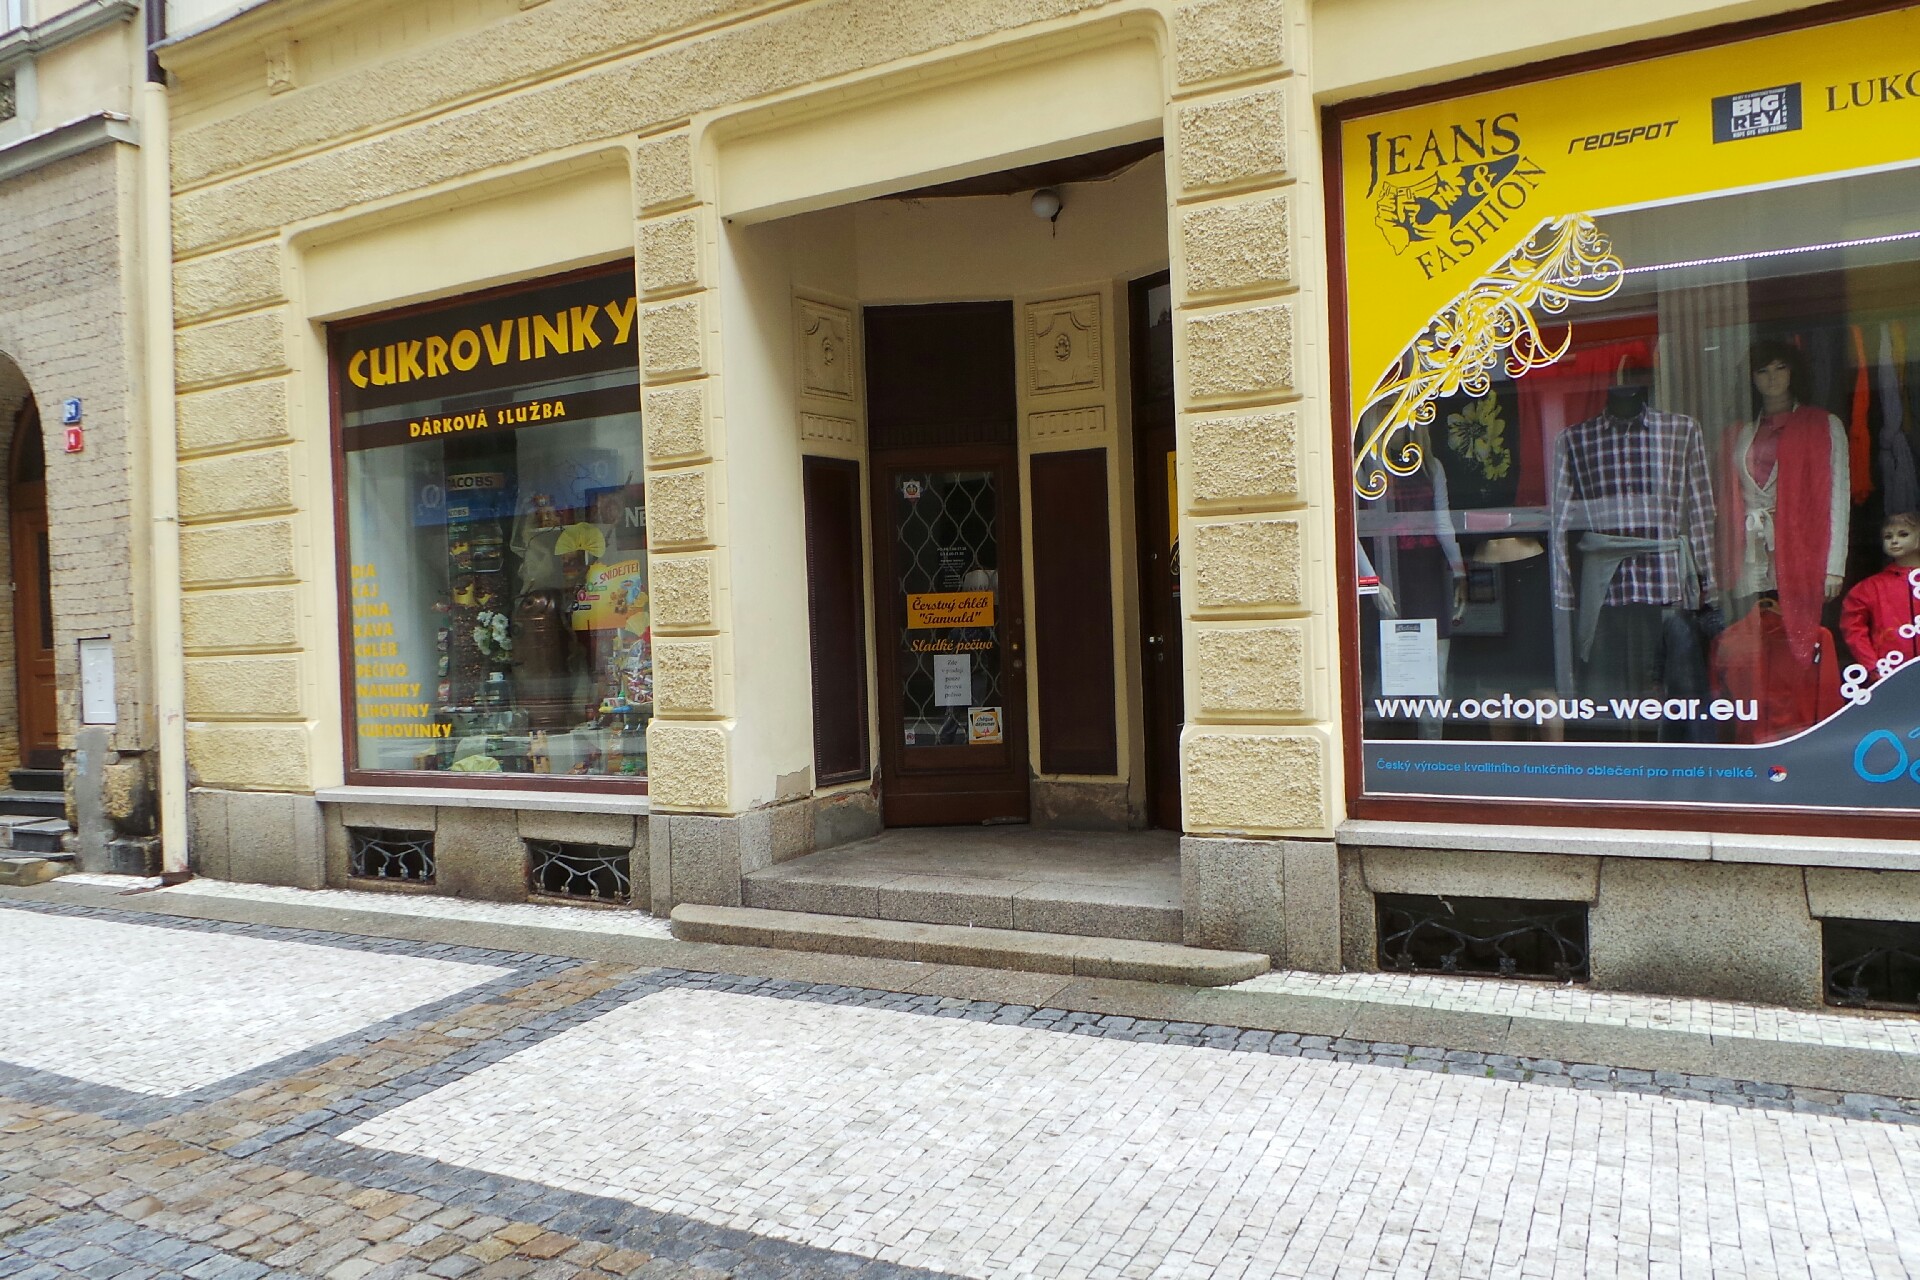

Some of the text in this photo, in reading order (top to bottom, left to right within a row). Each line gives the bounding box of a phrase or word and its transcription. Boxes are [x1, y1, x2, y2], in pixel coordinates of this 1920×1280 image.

[1732, 94, 1779, 117] BIG
[1731, 109, 1781, 133] REY
[1366, 113, 1521, 199] JEANS
[1467, 164, 1498, 197] &
[1414, 156, 1547, 281] FASHION
[349, 297, 637, 388] CUKROVINKY
[409, 401, 566, 438] DÁRKOVÁ SLUŽBA
[912, 596, 988, 613] Čerstvý chléb
[911, 638, 993, 654] Sladké pečivo
[1375, 693, 1759, 725] www.octopus-wear.eu
[358, 723, 453, 739] CUKROVINKY
[1376, 758, 1411, 772] Český
[1414, 760, 1461, 773] výrobce
[1464, 762, 1520, 774] kvalitního
[1523, 763, 1584, 775] funkčního
[1586, 765, 1644, 777] oblečení
[1646, 768, 1669, 779] pro
[1671, 766, 1706, 778] malé
[1716, 767, 1758, 779] velké.
